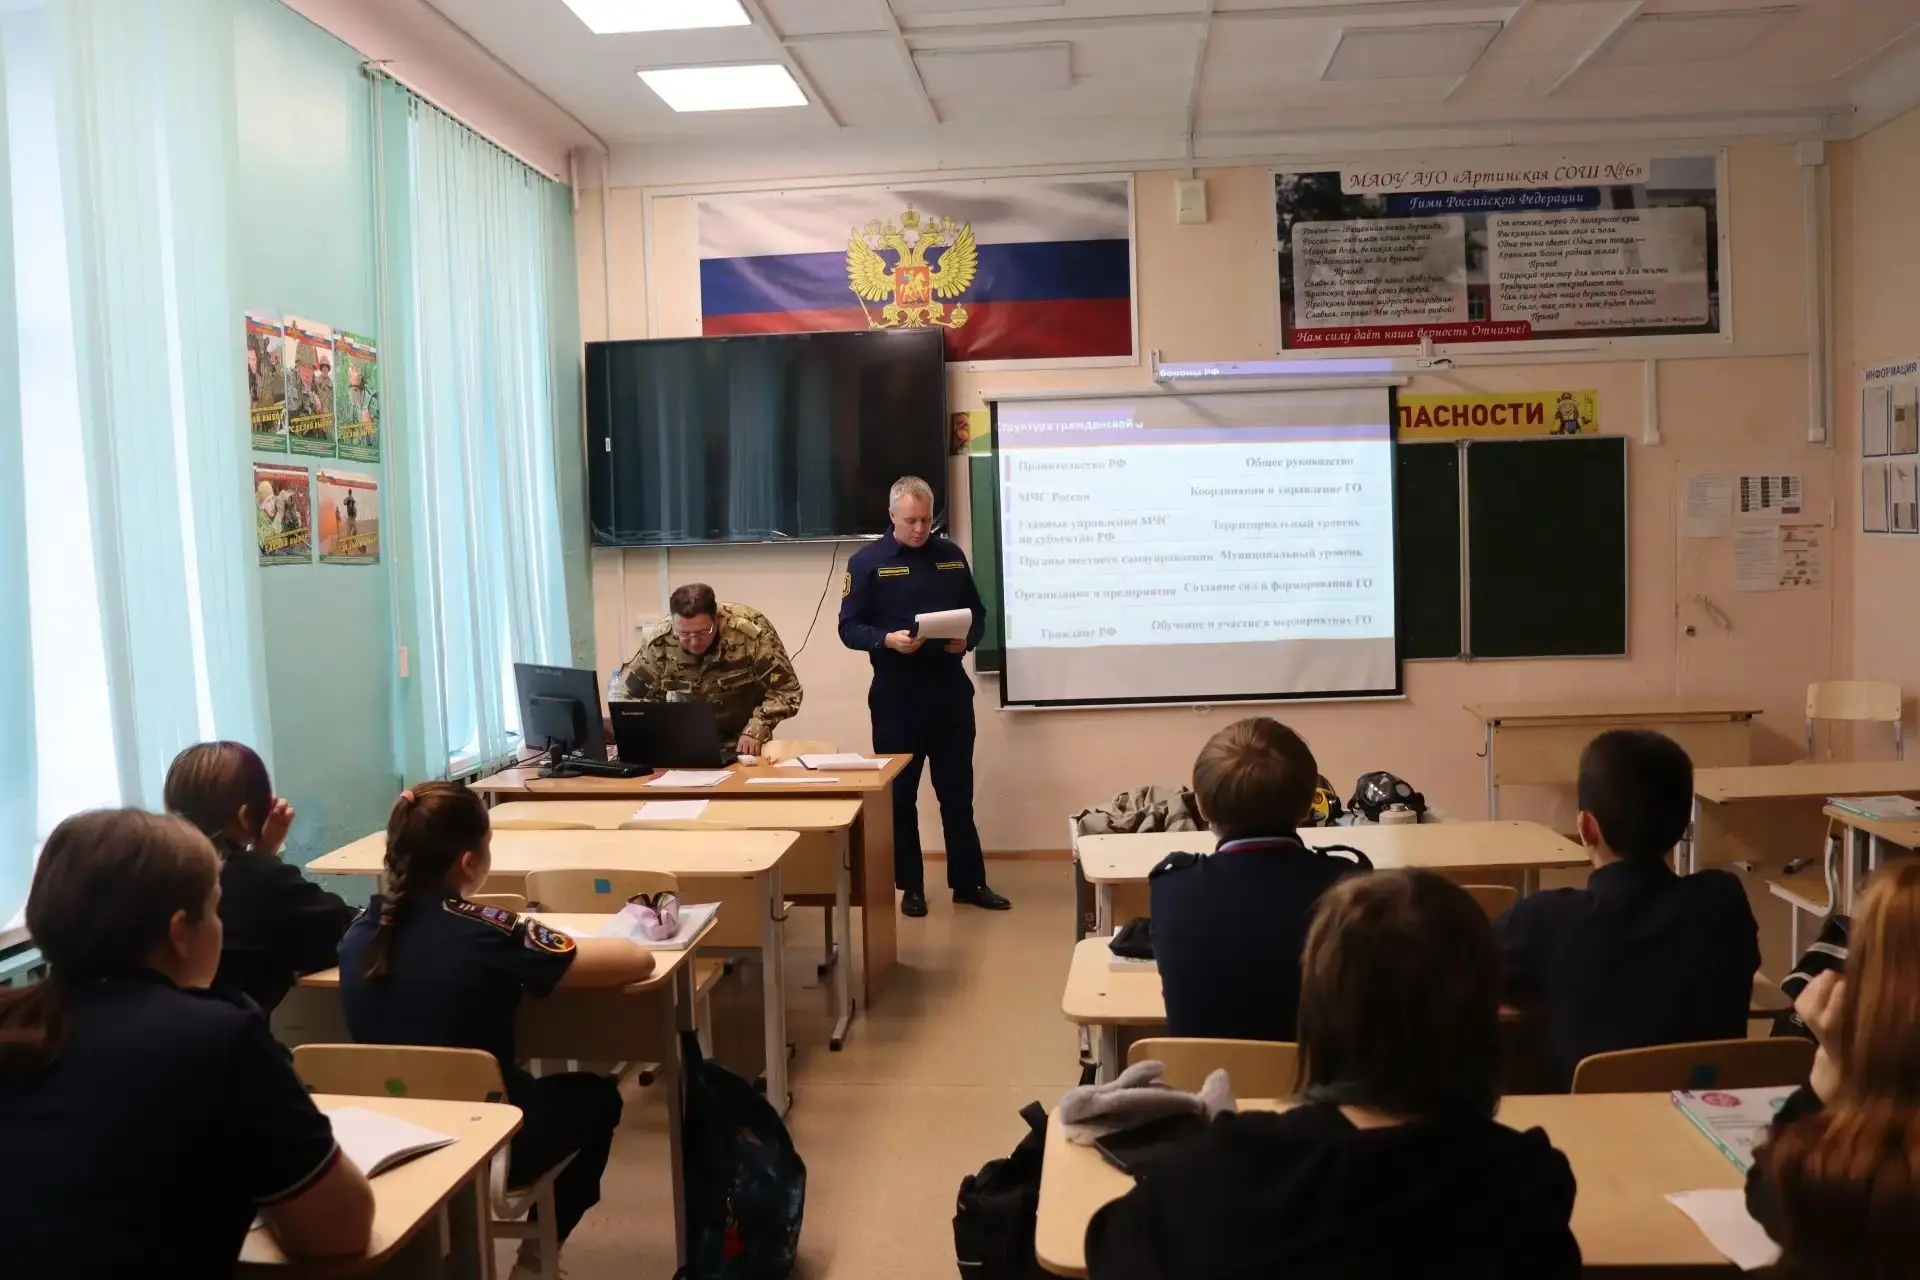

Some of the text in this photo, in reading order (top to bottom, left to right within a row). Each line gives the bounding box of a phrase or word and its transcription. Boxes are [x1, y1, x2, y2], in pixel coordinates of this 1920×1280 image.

[1350, 171, 1409, 189] МАОУ
[1453, 167, 1548, 188] «Артинская
[1554, 163, 1600, 181] СОШ
[1410, 191, 1584, 211] Гимн Российской Федерации
[1297, 330, 1322, 343] Нам
[1325, 330, 1350, 345] силу
[1353, 327, 1382, 342] даёт
[1385, 326, 1413, 339] наша
[1471, 321, 1527, 336] Отчизне!
[1865, 361, 1918, 381] ИНФОРМАЦИЯ
[1397, 402, 1544, 429] ПАСНОСТИ
